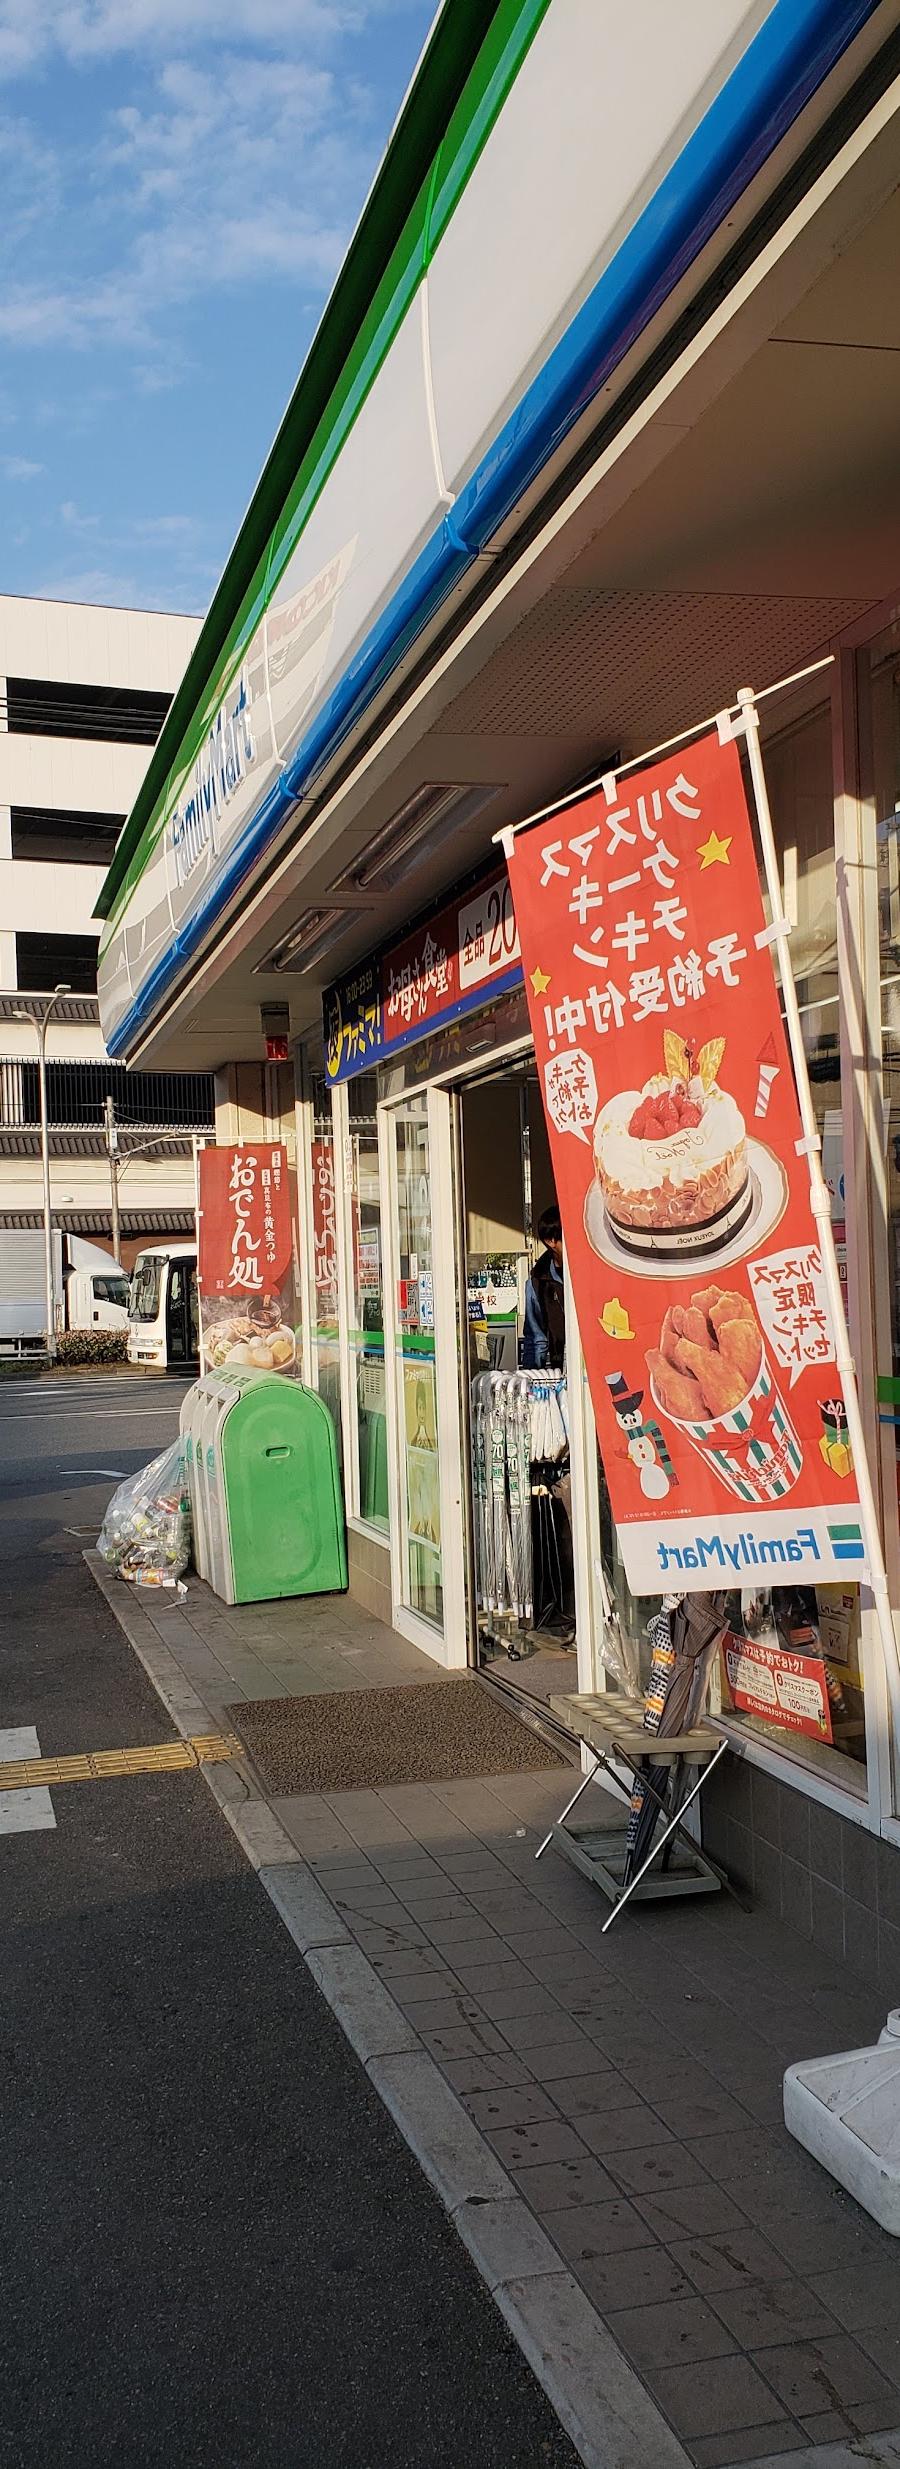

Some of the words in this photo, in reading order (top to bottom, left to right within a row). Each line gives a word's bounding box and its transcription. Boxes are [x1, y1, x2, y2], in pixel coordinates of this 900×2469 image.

[172, 664, 255, 888] FamilyMart
[387, 932, 450, 1022] お母さん食堂
[463, 920, 485, 967] 全品
[227, 1153, 264, 1290] おでん処
